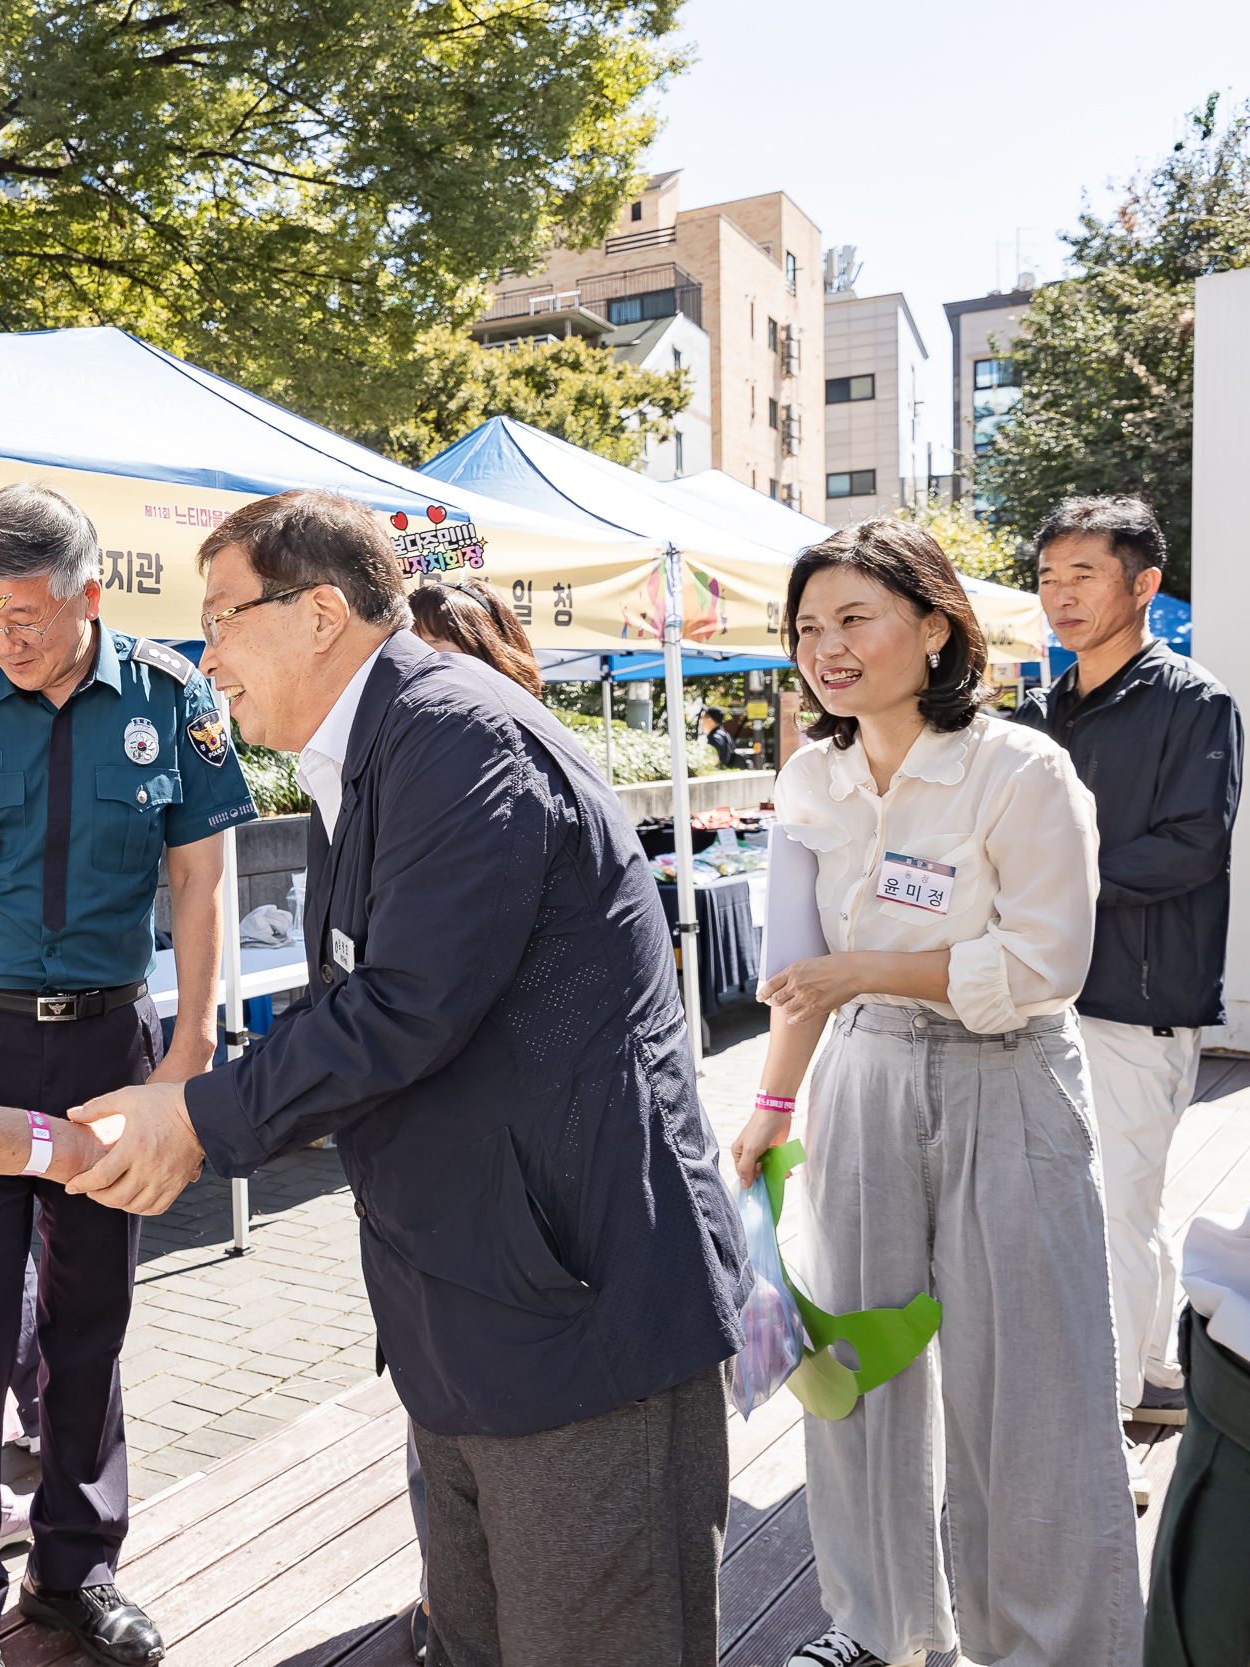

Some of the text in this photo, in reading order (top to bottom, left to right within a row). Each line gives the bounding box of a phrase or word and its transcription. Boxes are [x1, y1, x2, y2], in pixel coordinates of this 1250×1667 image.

[144, 505, 234, 528] 제11회 느티마을
[208, 745, 225, 758] POLICE
